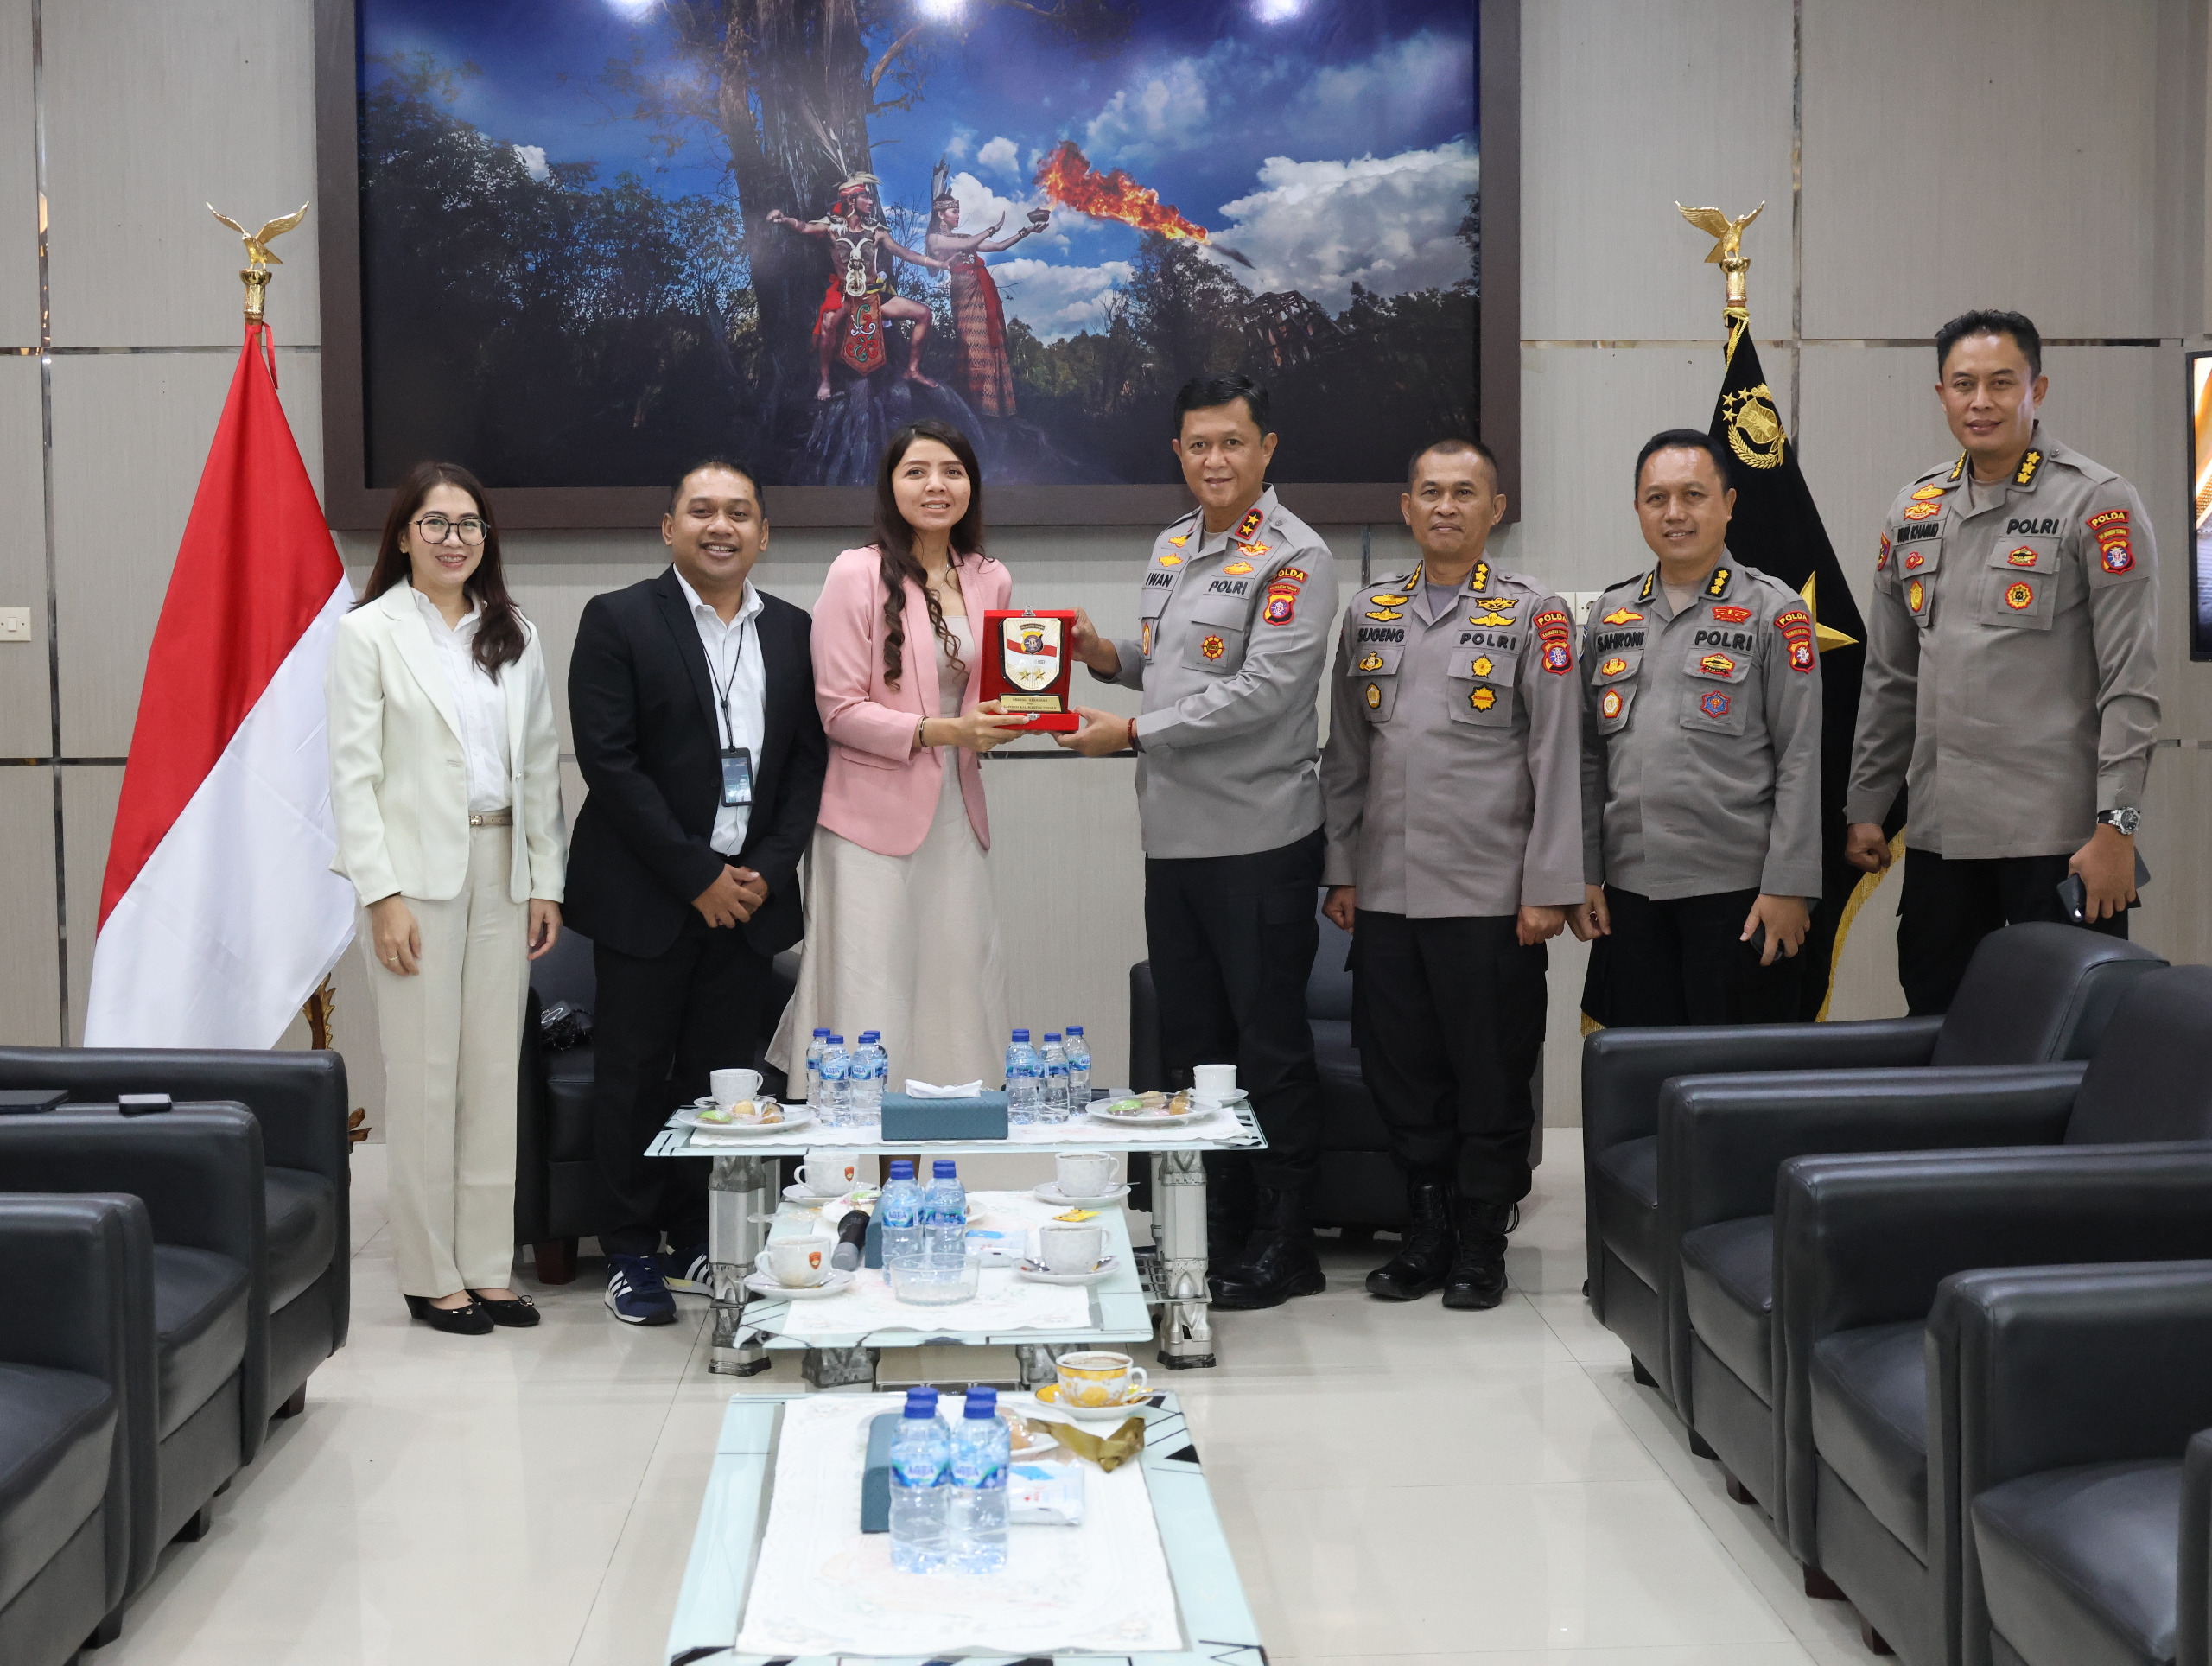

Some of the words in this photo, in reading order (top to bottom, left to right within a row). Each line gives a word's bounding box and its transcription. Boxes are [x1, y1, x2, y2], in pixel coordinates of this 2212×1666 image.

[2006, 518, 2059, 535] POLRI
[2091, 512, 2126, 526] POLDA
[1145, 572, 1173, 588] IWAN
[1208, 580, 1249, 595] POLRI
[1779, 612, 1808, 625] POLDA
[1357, 627, 1405, 643] SUGENG
[1460, 633, 1516, 651] POLRI
[1597, 632, 1644, 652] SAHRONI
[1694, 630, 1753, 651] POLRI
